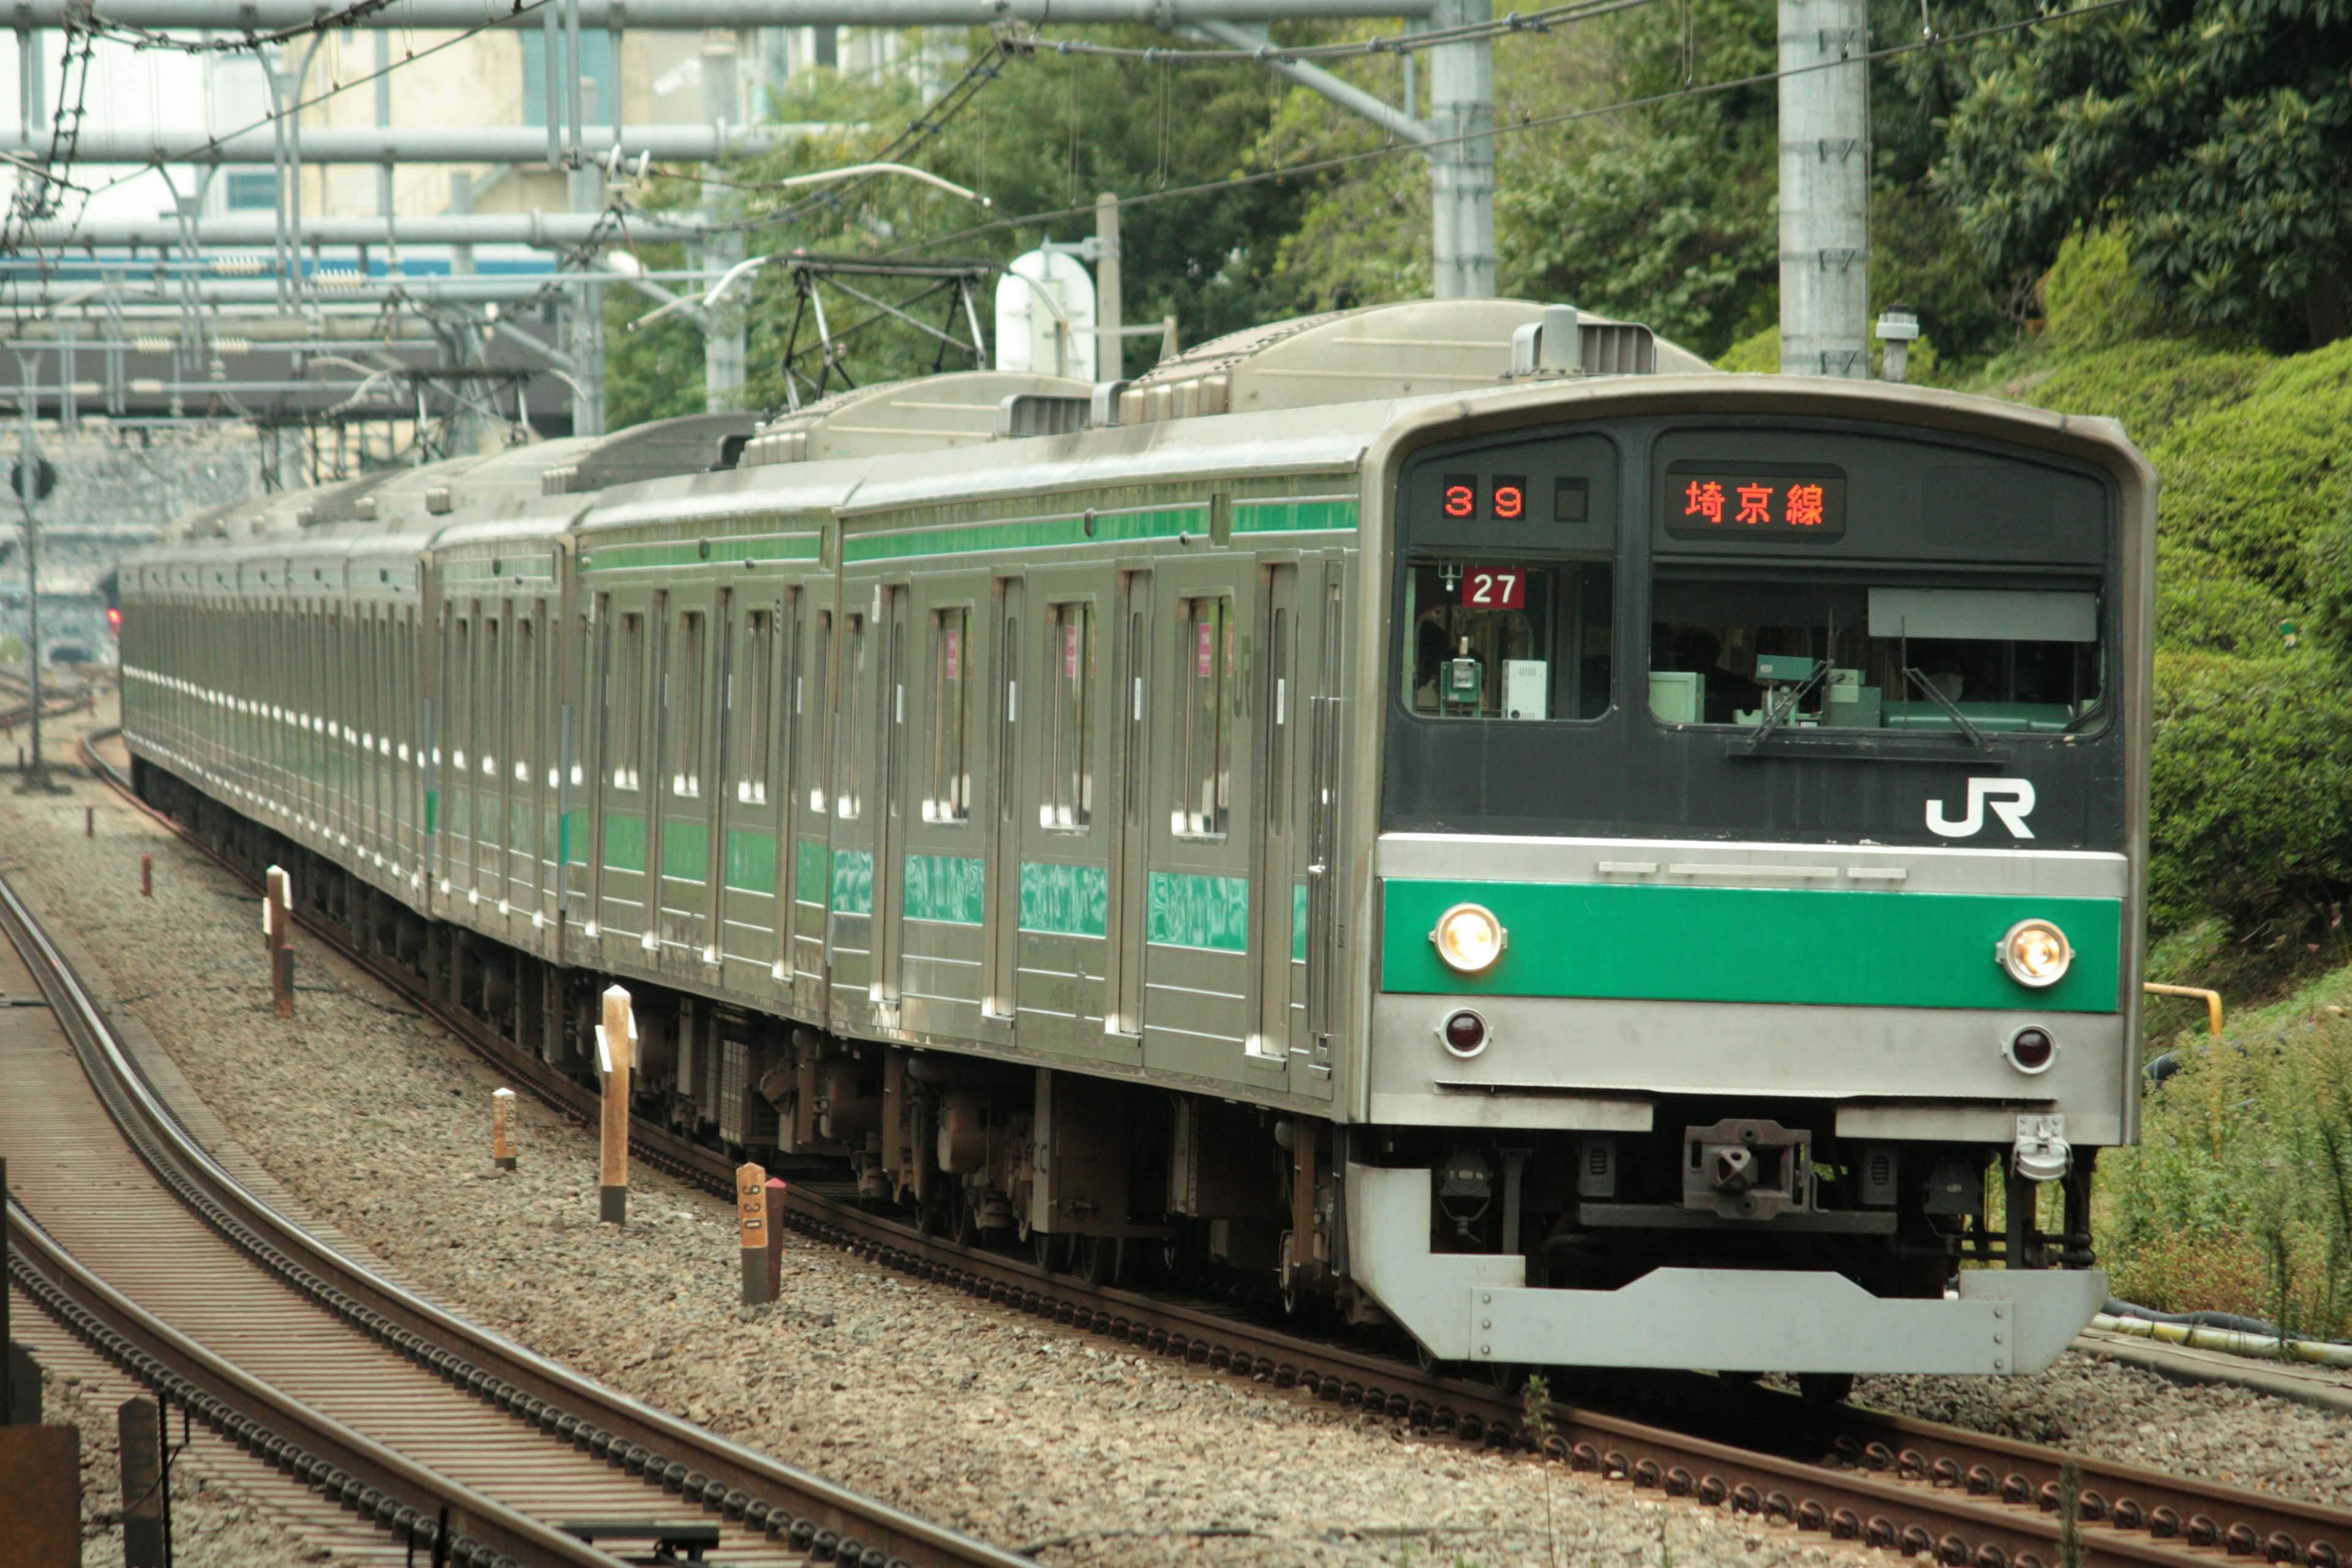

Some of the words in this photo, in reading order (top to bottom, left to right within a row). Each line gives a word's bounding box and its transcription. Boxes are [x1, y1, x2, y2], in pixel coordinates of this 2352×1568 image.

[1684, 481, 1825, 526] 埼京線
[1472, 573, 1516, 603] 27
[1925, 777, 2036, 839] JR
[742, 1184, 762, 1229] 930
